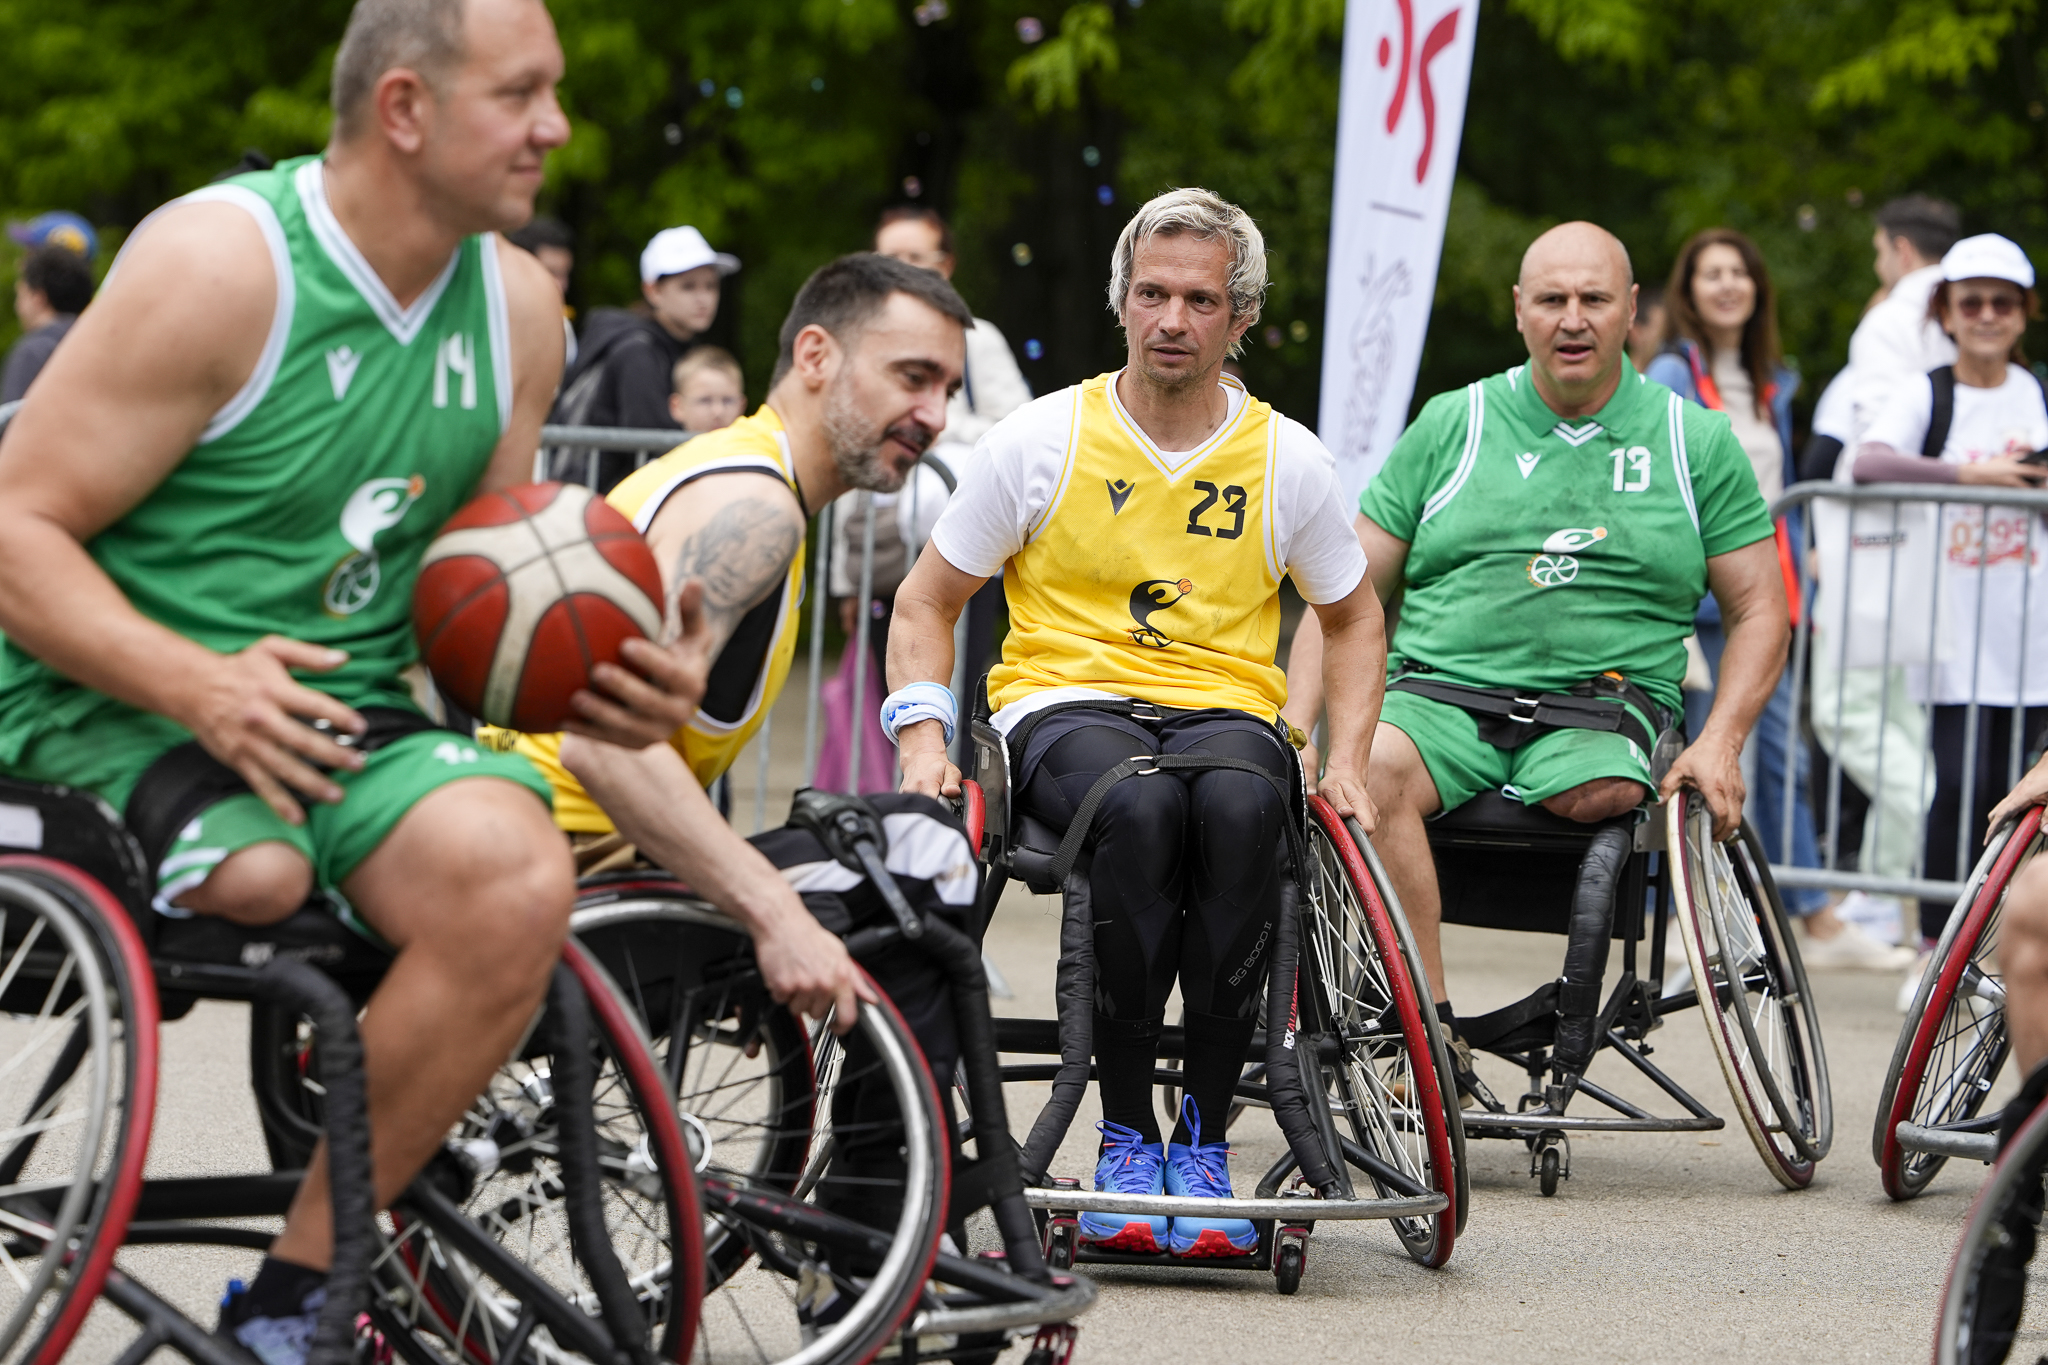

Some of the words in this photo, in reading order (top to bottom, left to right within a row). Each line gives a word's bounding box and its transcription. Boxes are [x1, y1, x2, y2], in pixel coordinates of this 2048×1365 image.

[1608, 445, 1652, 493] 13
[1186, 479, 1248, 541] 23
[1228, 967, 1248, 987] BG
[1244, 930, 1269, 968] 8000
